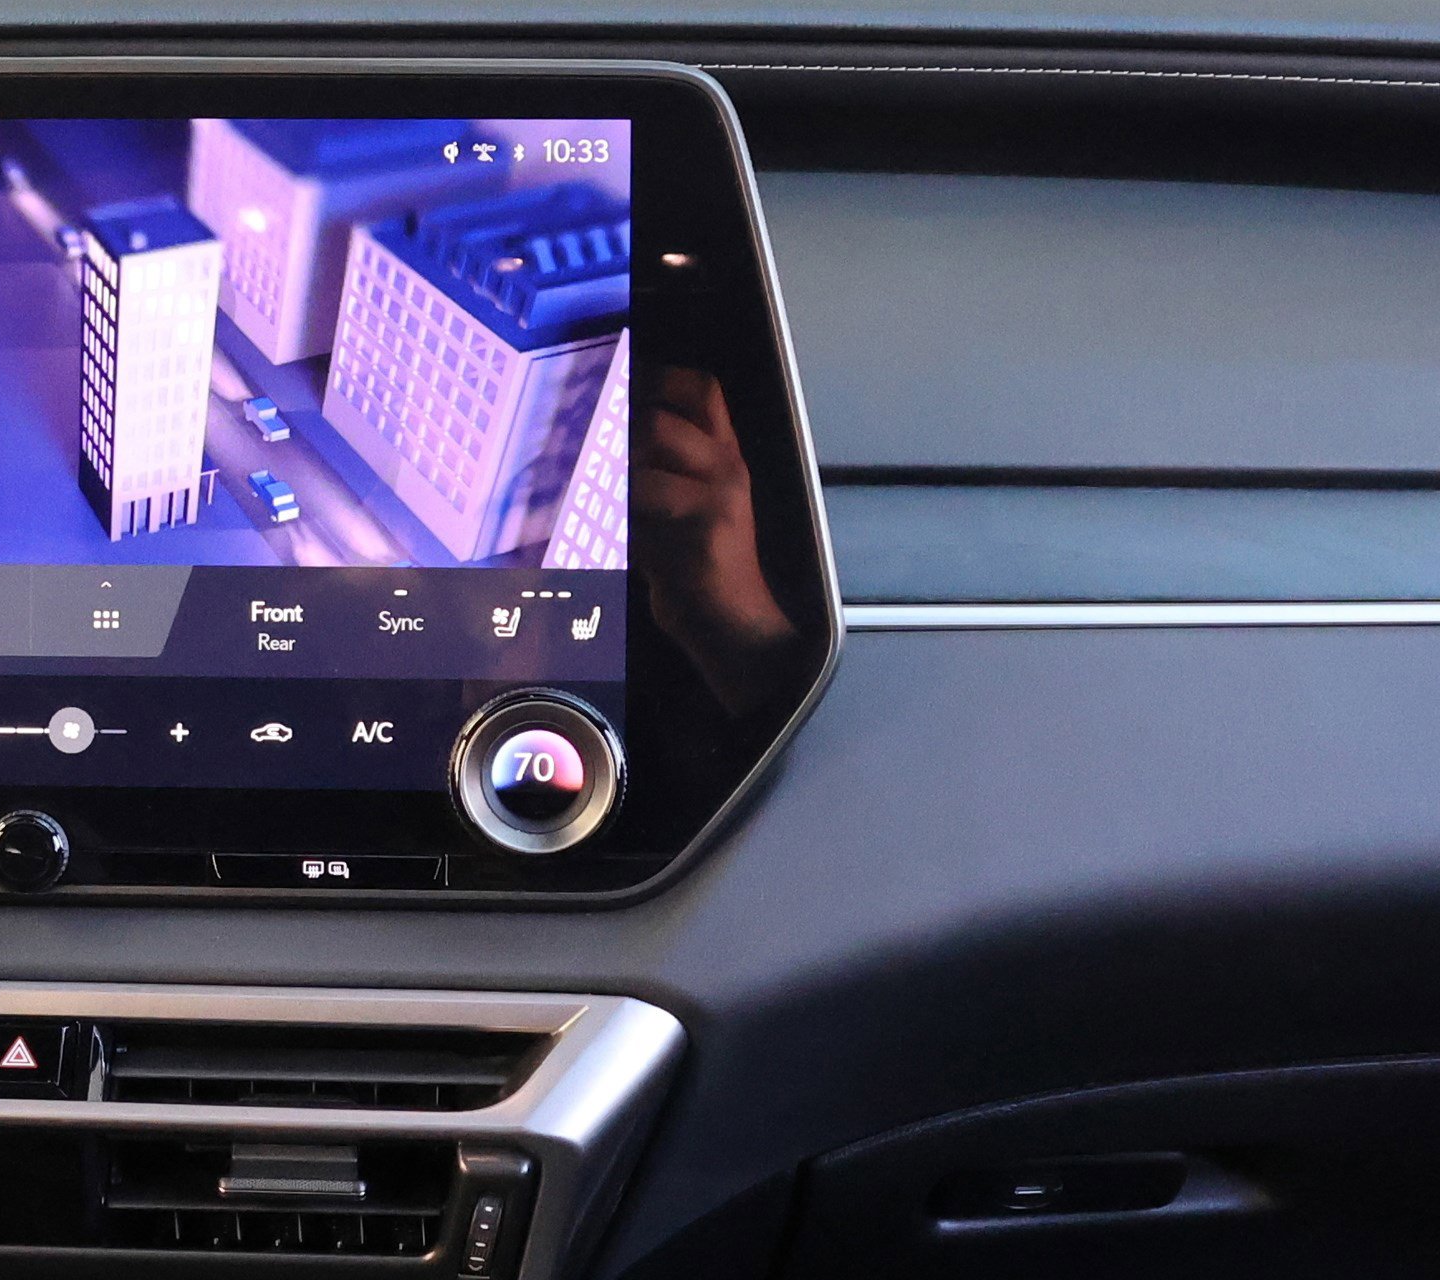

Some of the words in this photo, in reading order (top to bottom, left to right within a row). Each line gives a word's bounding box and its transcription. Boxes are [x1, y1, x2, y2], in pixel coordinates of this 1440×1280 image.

[542, 139, 610, 164] 10:33
[251, 601, 303, 622] Front
[378, 611, 424, 635] Sync
[258, 635, 295, 652] Rear
[352, 722, 394, 744] A/C
[513, 752, 555, 782] 70
